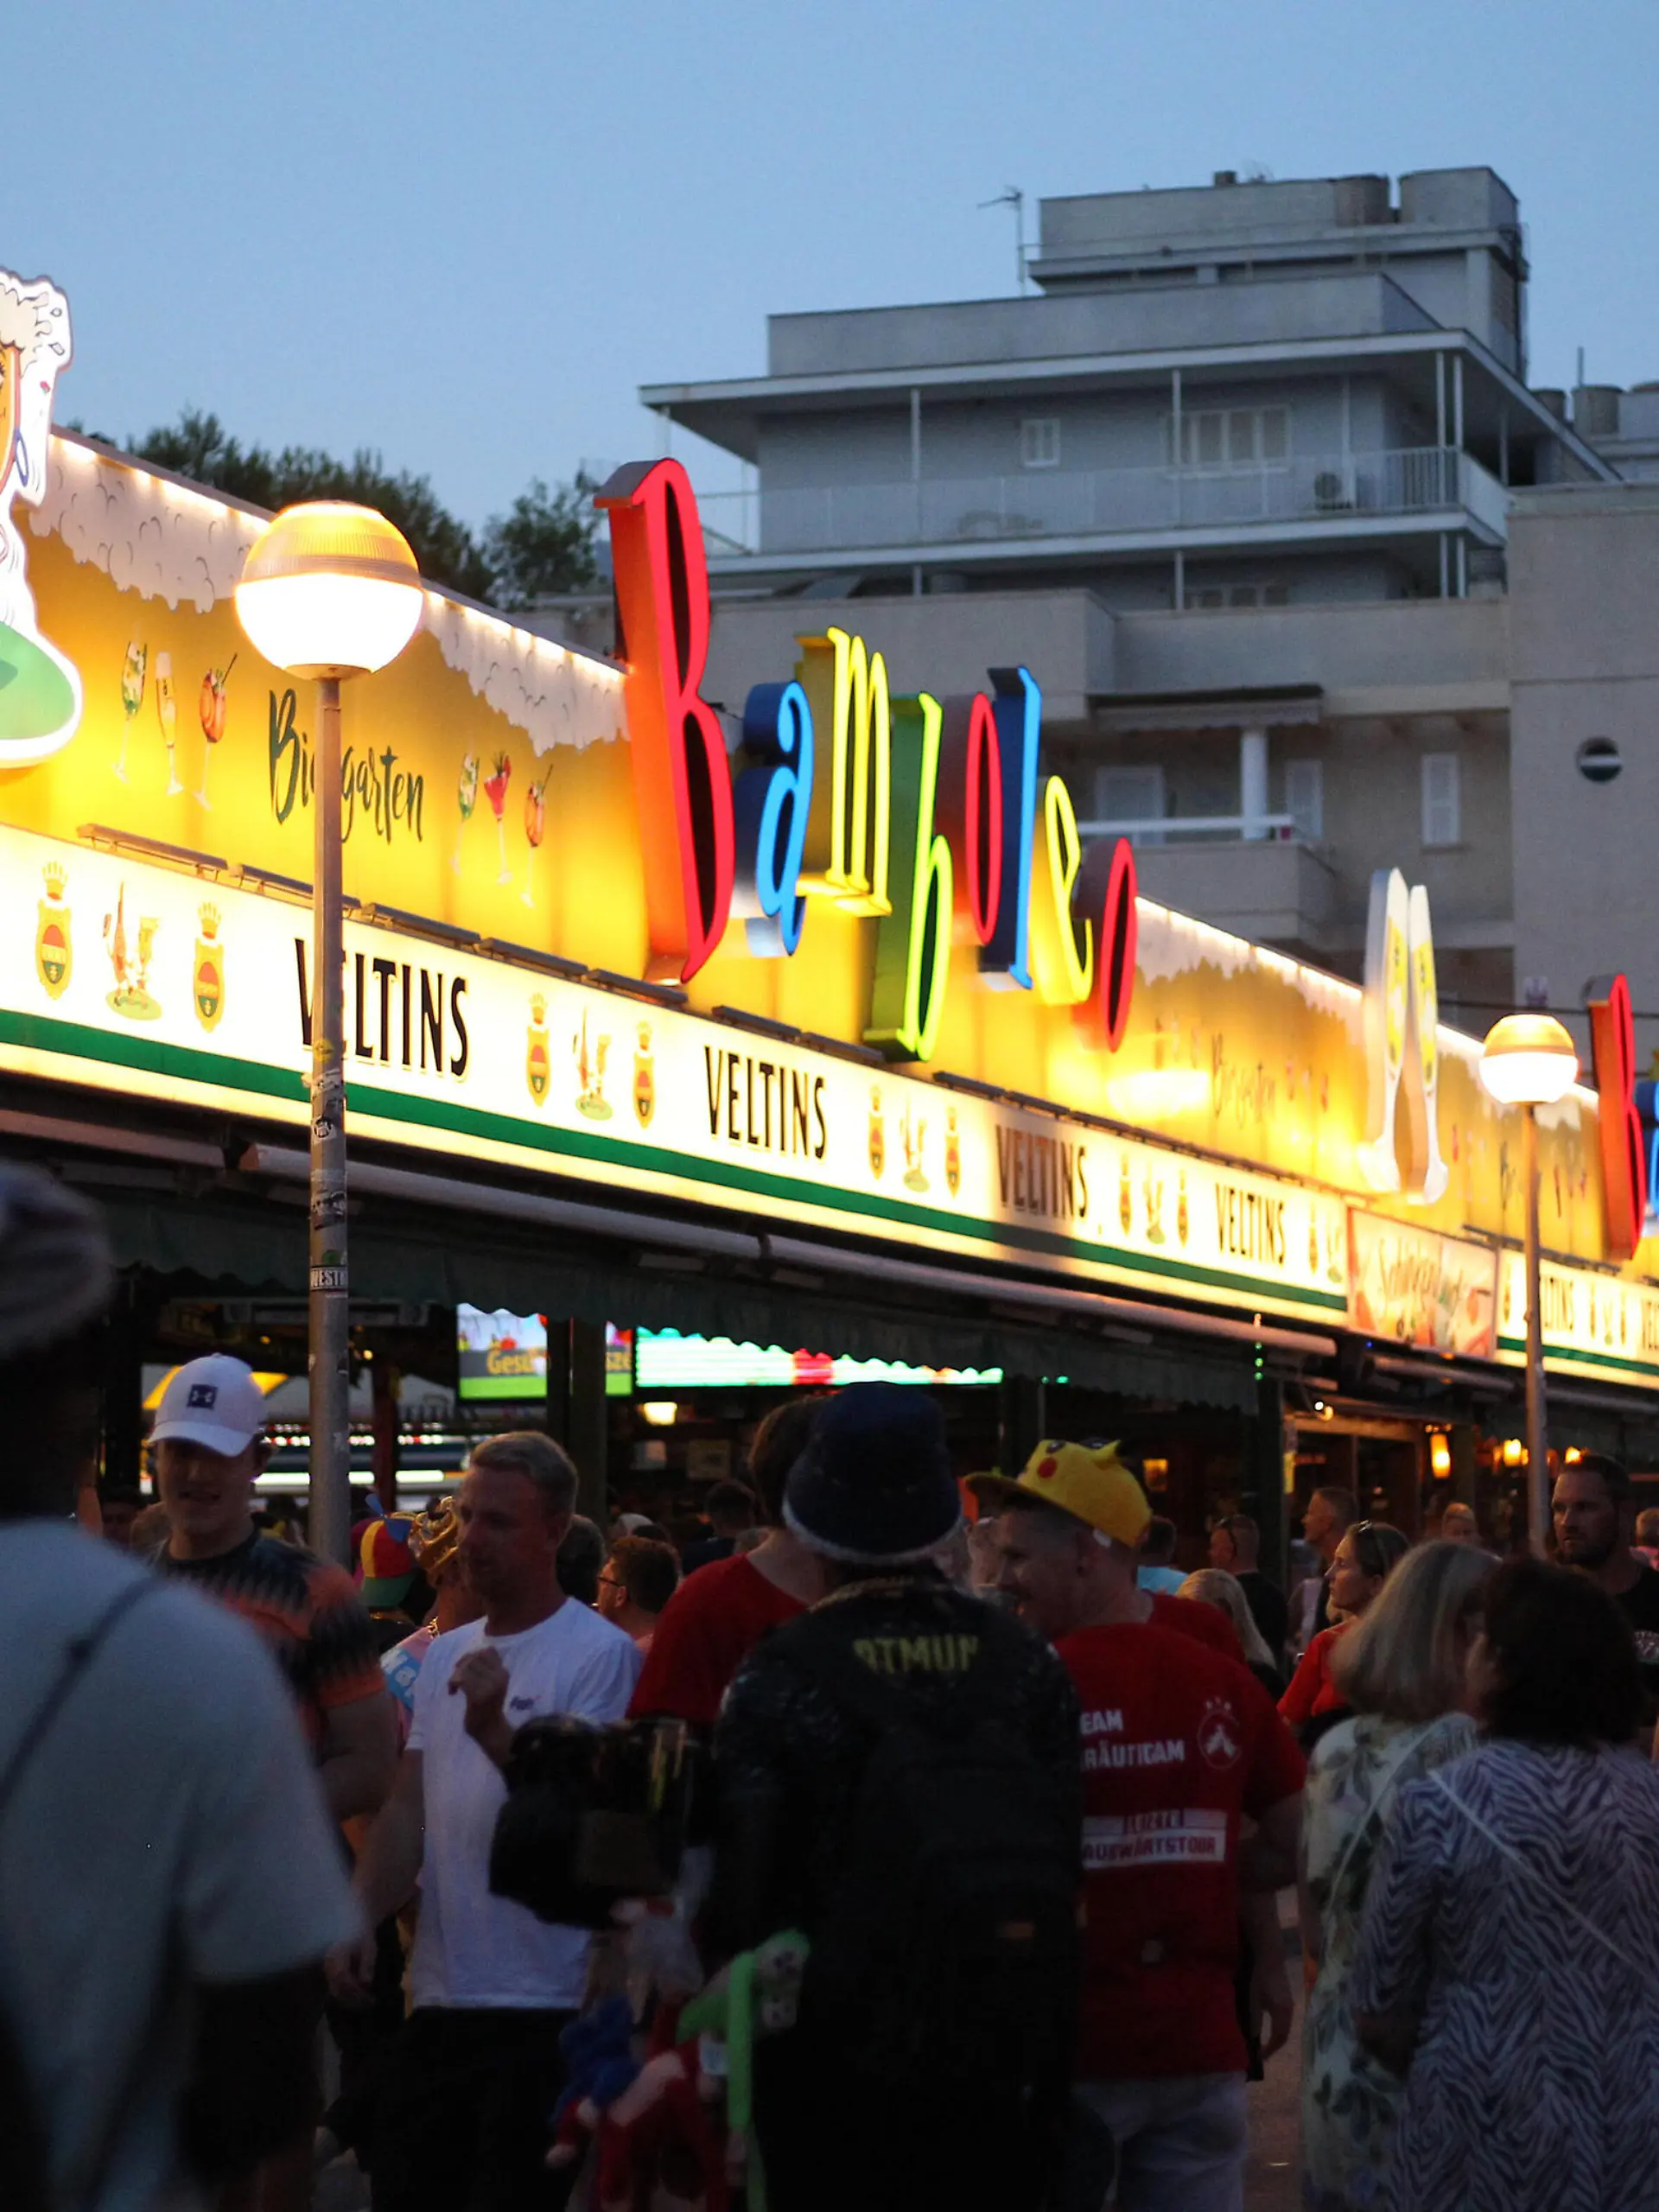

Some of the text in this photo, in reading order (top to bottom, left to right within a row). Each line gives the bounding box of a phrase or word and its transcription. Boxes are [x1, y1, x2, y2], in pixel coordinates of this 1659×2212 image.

[269, 689, 424, 845] Bigarten
[594, 458, 1137, 1061] Bamboleo
[295, 938, 467, 1077] VLTINS
[704, 1046, 826, 1159] VELTINS
[995, 1124, 1087, 1219] VELTINS
[1215, 1182, 1286, 1265] VELTINS
[1080, 1709, 1123, 1735] EAM
[1083, 1738, 1185, 1769] RÄUTIGAM
